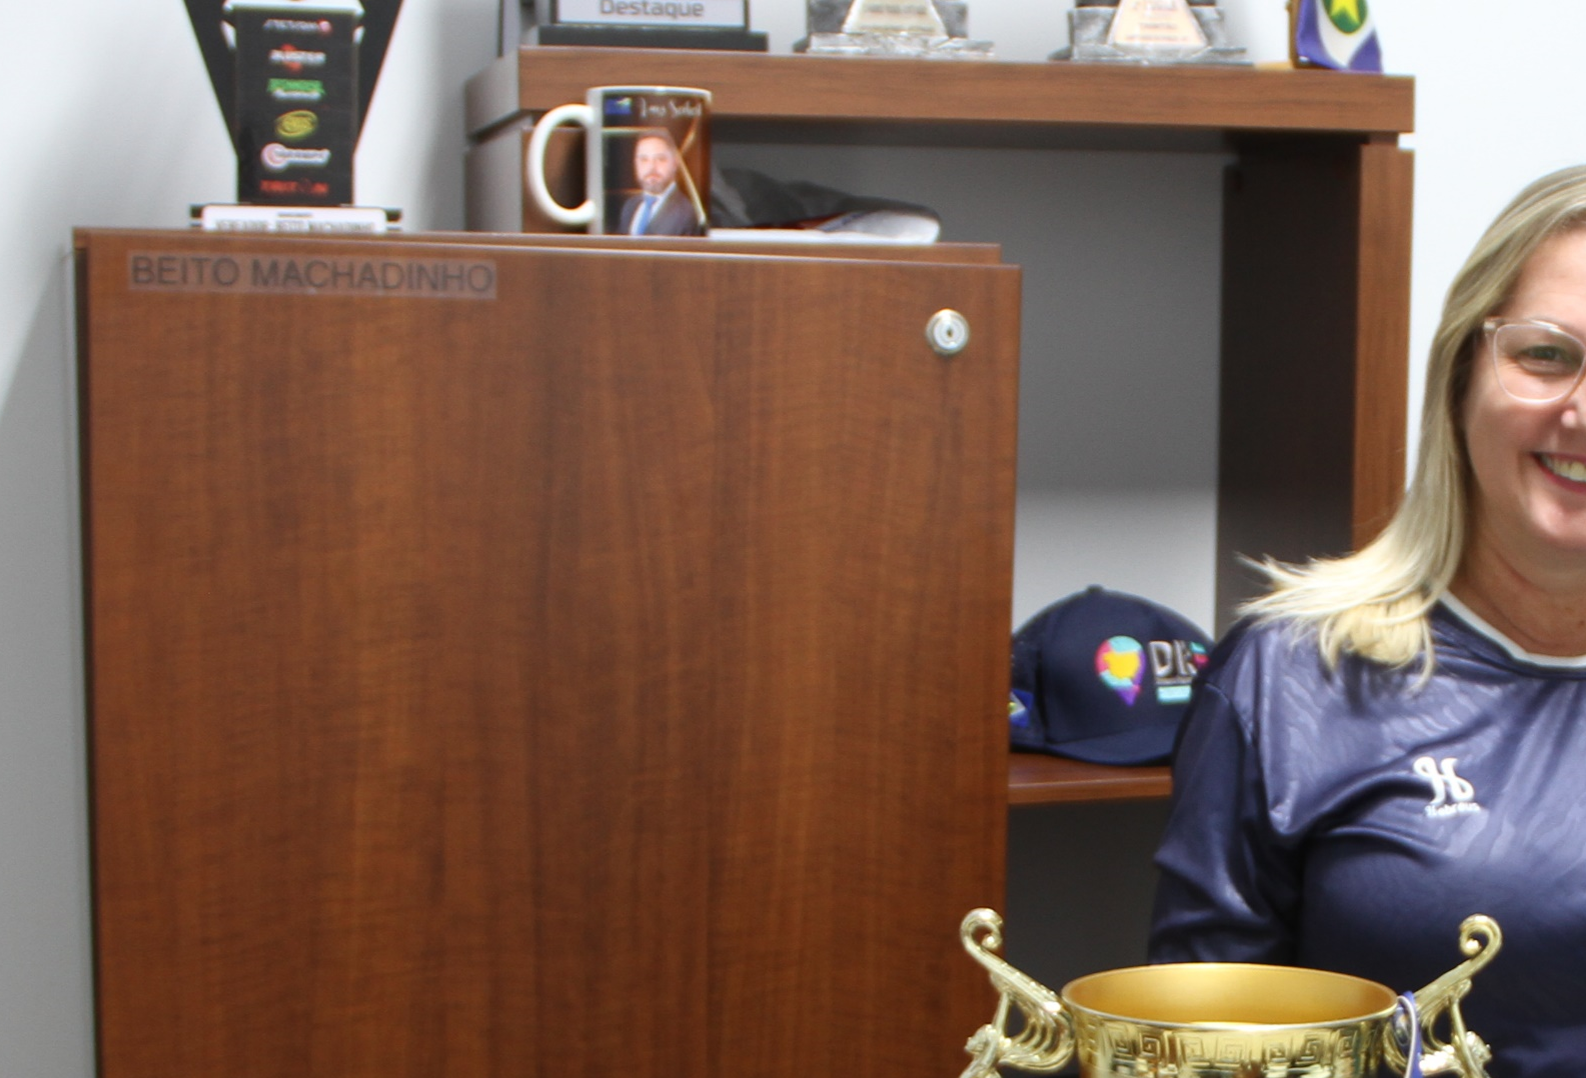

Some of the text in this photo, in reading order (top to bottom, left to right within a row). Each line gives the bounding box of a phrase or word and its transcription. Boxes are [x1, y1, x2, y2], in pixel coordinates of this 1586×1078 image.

[600, 0, 705, 18] Destaque
[131, 255, 494, 293] BEITO MACHADINHO
